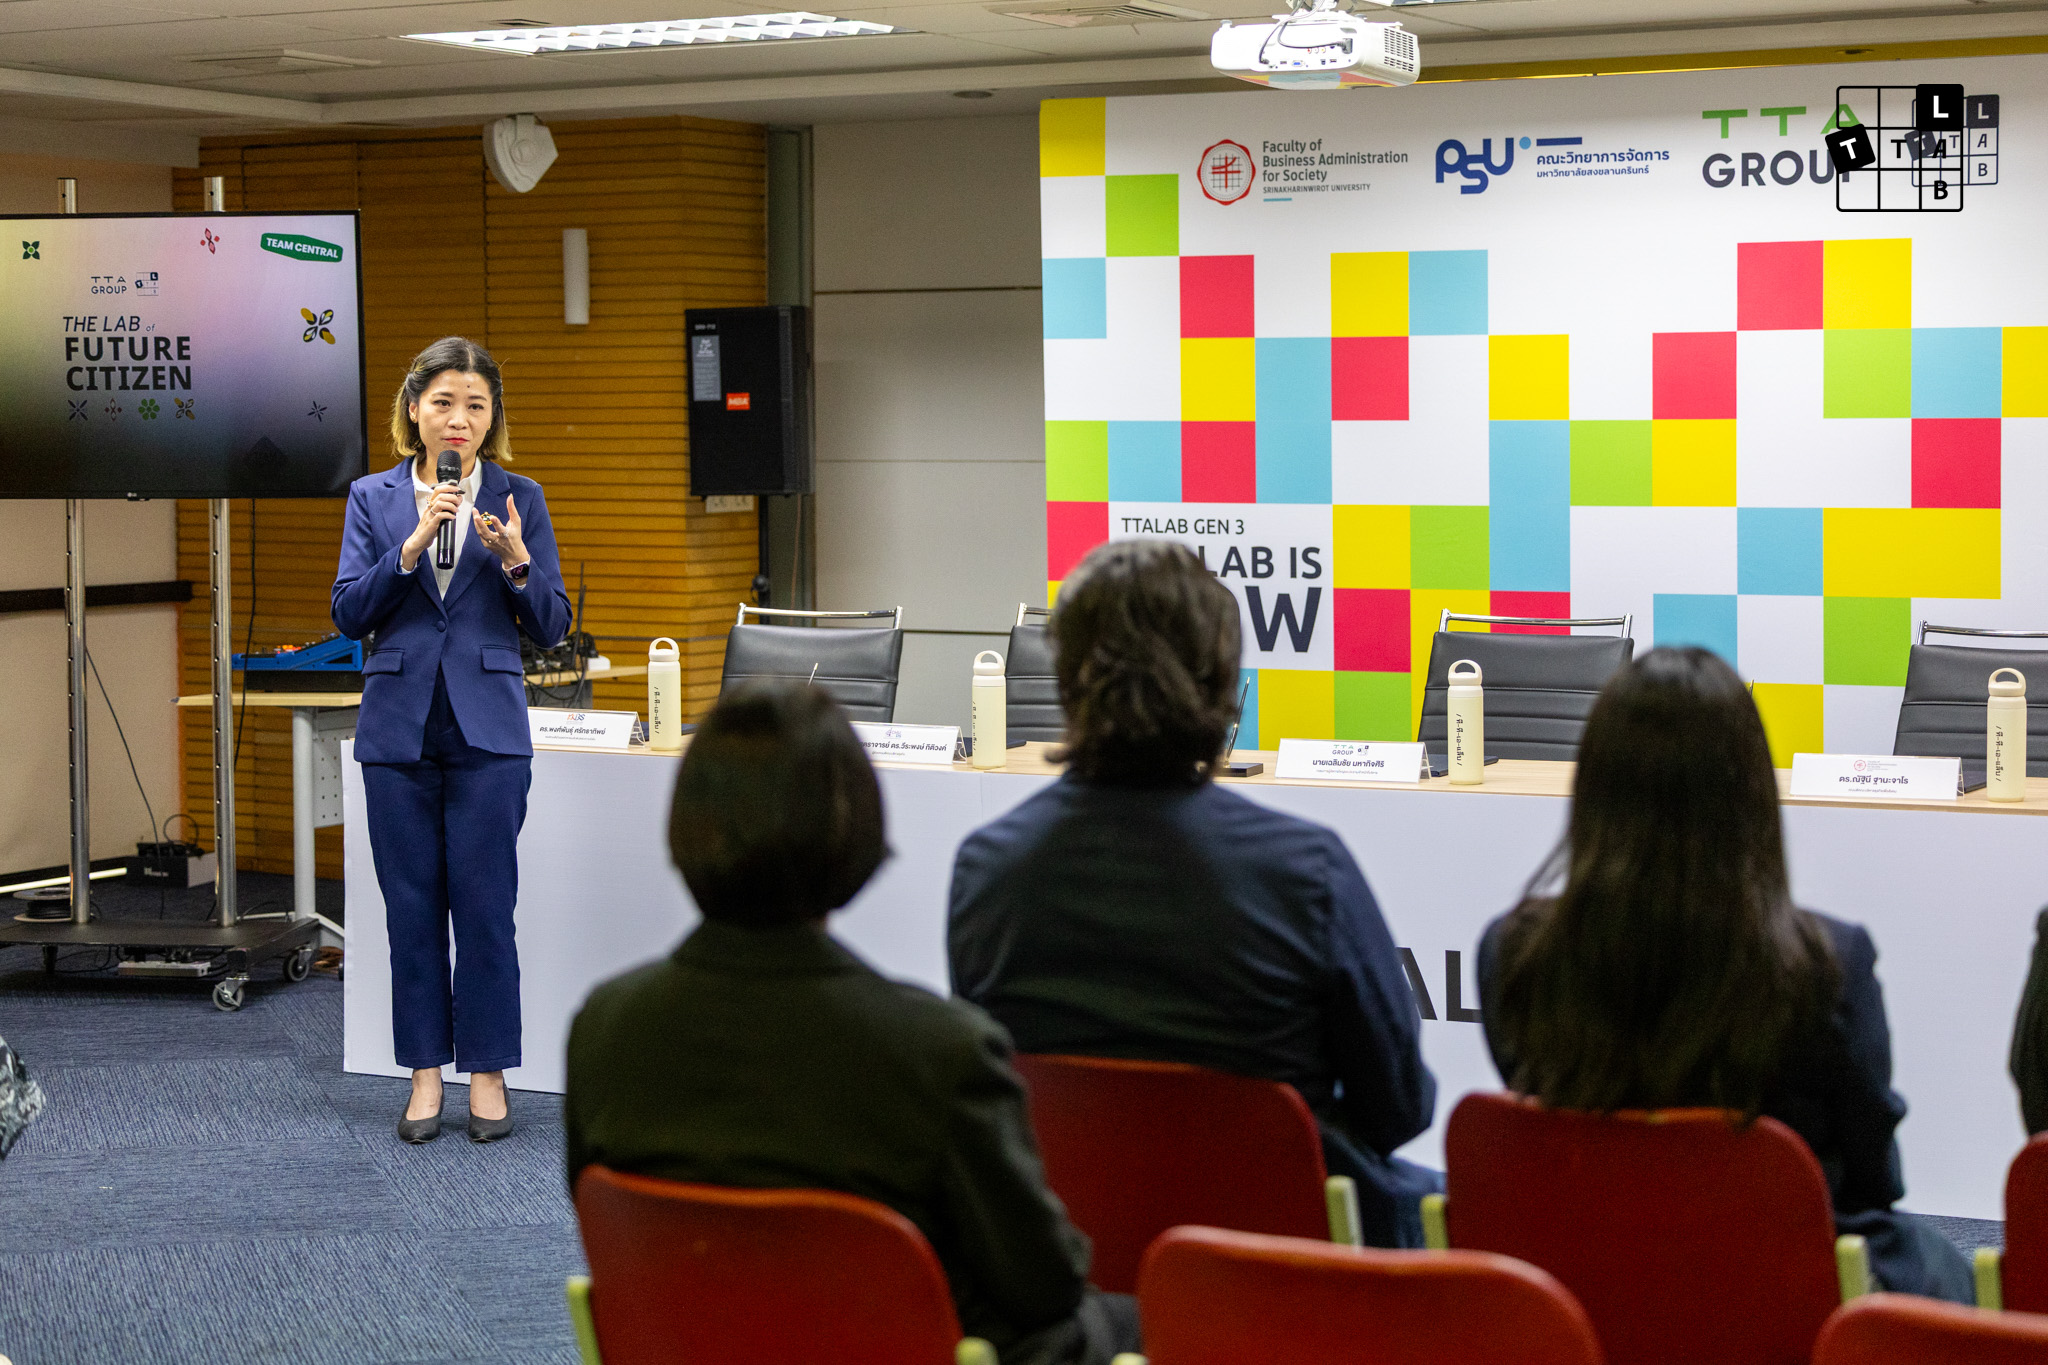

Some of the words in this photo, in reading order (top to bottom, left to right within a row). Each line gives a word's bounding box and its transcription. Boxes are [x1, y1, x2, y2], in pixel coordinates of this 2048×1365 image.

[1262, 139, 1306, 154] Faculty
[1309, 138, 1323, 152] of
[1262, 154, 1315, 168] Business
[1318, 151, 1409, 166] Administration
[1536, 147, 1670, 165] คณะวิทยาการจัดการ
[1262, 169, 1280, 182] for
[1283, 168, 1328, 183] Society
[1536, 164, 1650, 178] มหาวิทยาลัยสงขลานครินทร์
[1263, 184, 1330, 194] SRINAKHARINWIROT
[1331, 183, 1371, 192] UNIVERSITY
[266, 237, 294, 251] TEAM
[294, 243, 339, 259] CENTRAL
[90, 276, 127, 284] TTA
[90, 285, 128, 294] GROUP
[63, 315, 98, 333] THE
[103, 315, 141, 332] LAB
[146, 323, 156, 332] of
[65, 335, 192, 362] FUTURE
[66, 365, 192, 391] CITIZEN
[1121, 517, 1188, 534] TTALAB
[1193, 518, 1230, 535] GEN
[1234, 518, 1245, 535] 3
[1289, 546, 1322, 580] IS
